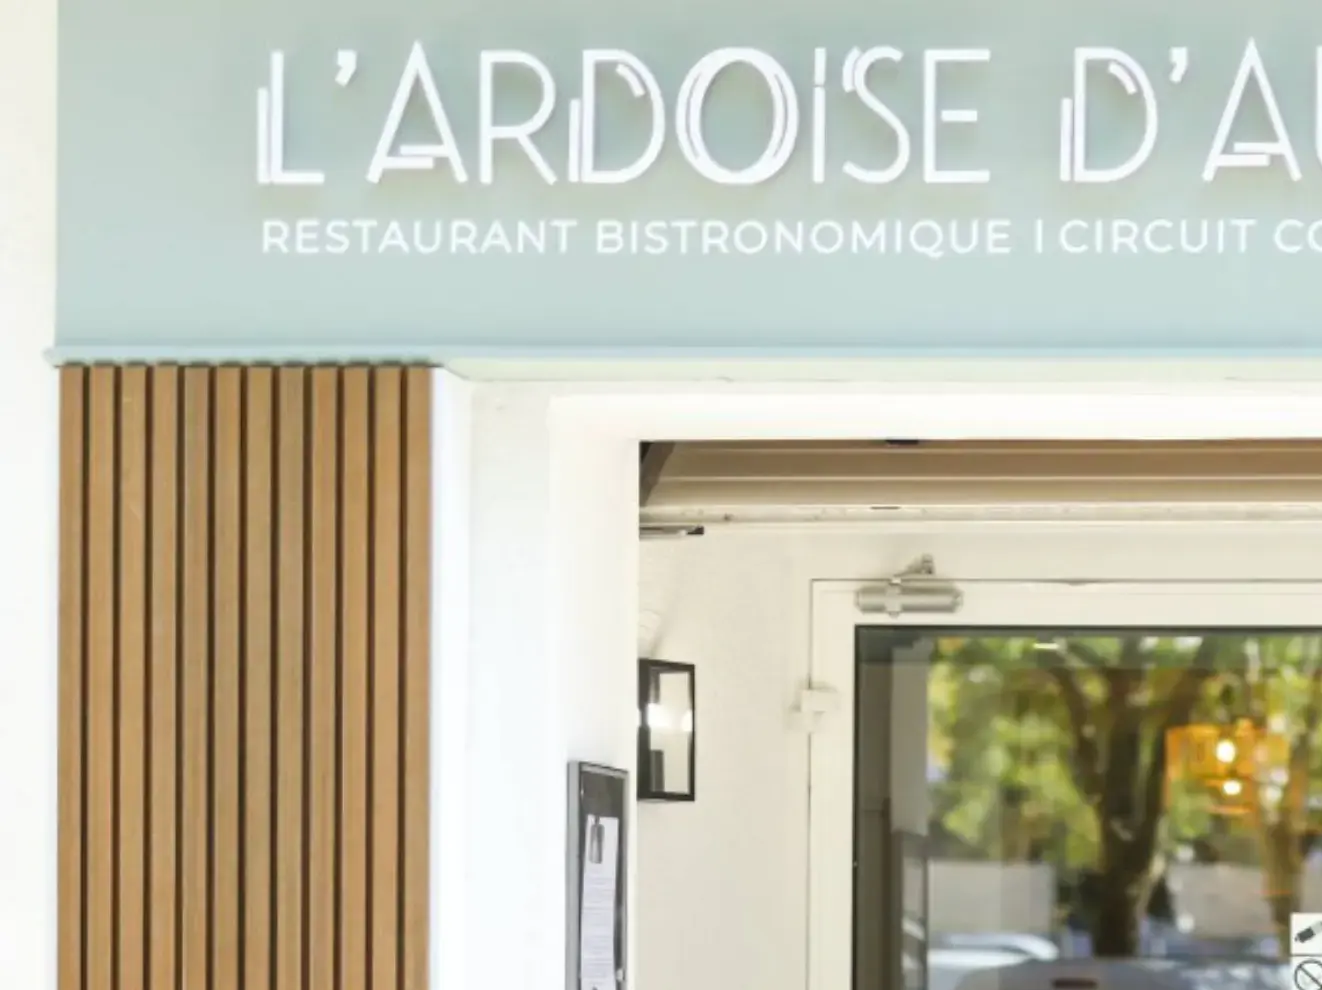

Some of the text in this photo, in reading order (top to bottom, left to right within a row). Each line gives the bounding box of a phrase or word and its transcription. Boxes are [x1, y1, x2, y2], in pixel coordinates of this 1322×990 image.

[257, 40, 991, 185] L'ARDOISE
[262, 219, 577, 254] RESTAURANT
[596, 219, 1011, 259] BISTRONOMIQUE
[1059, 219, 1256, 253] CIRCUIT
